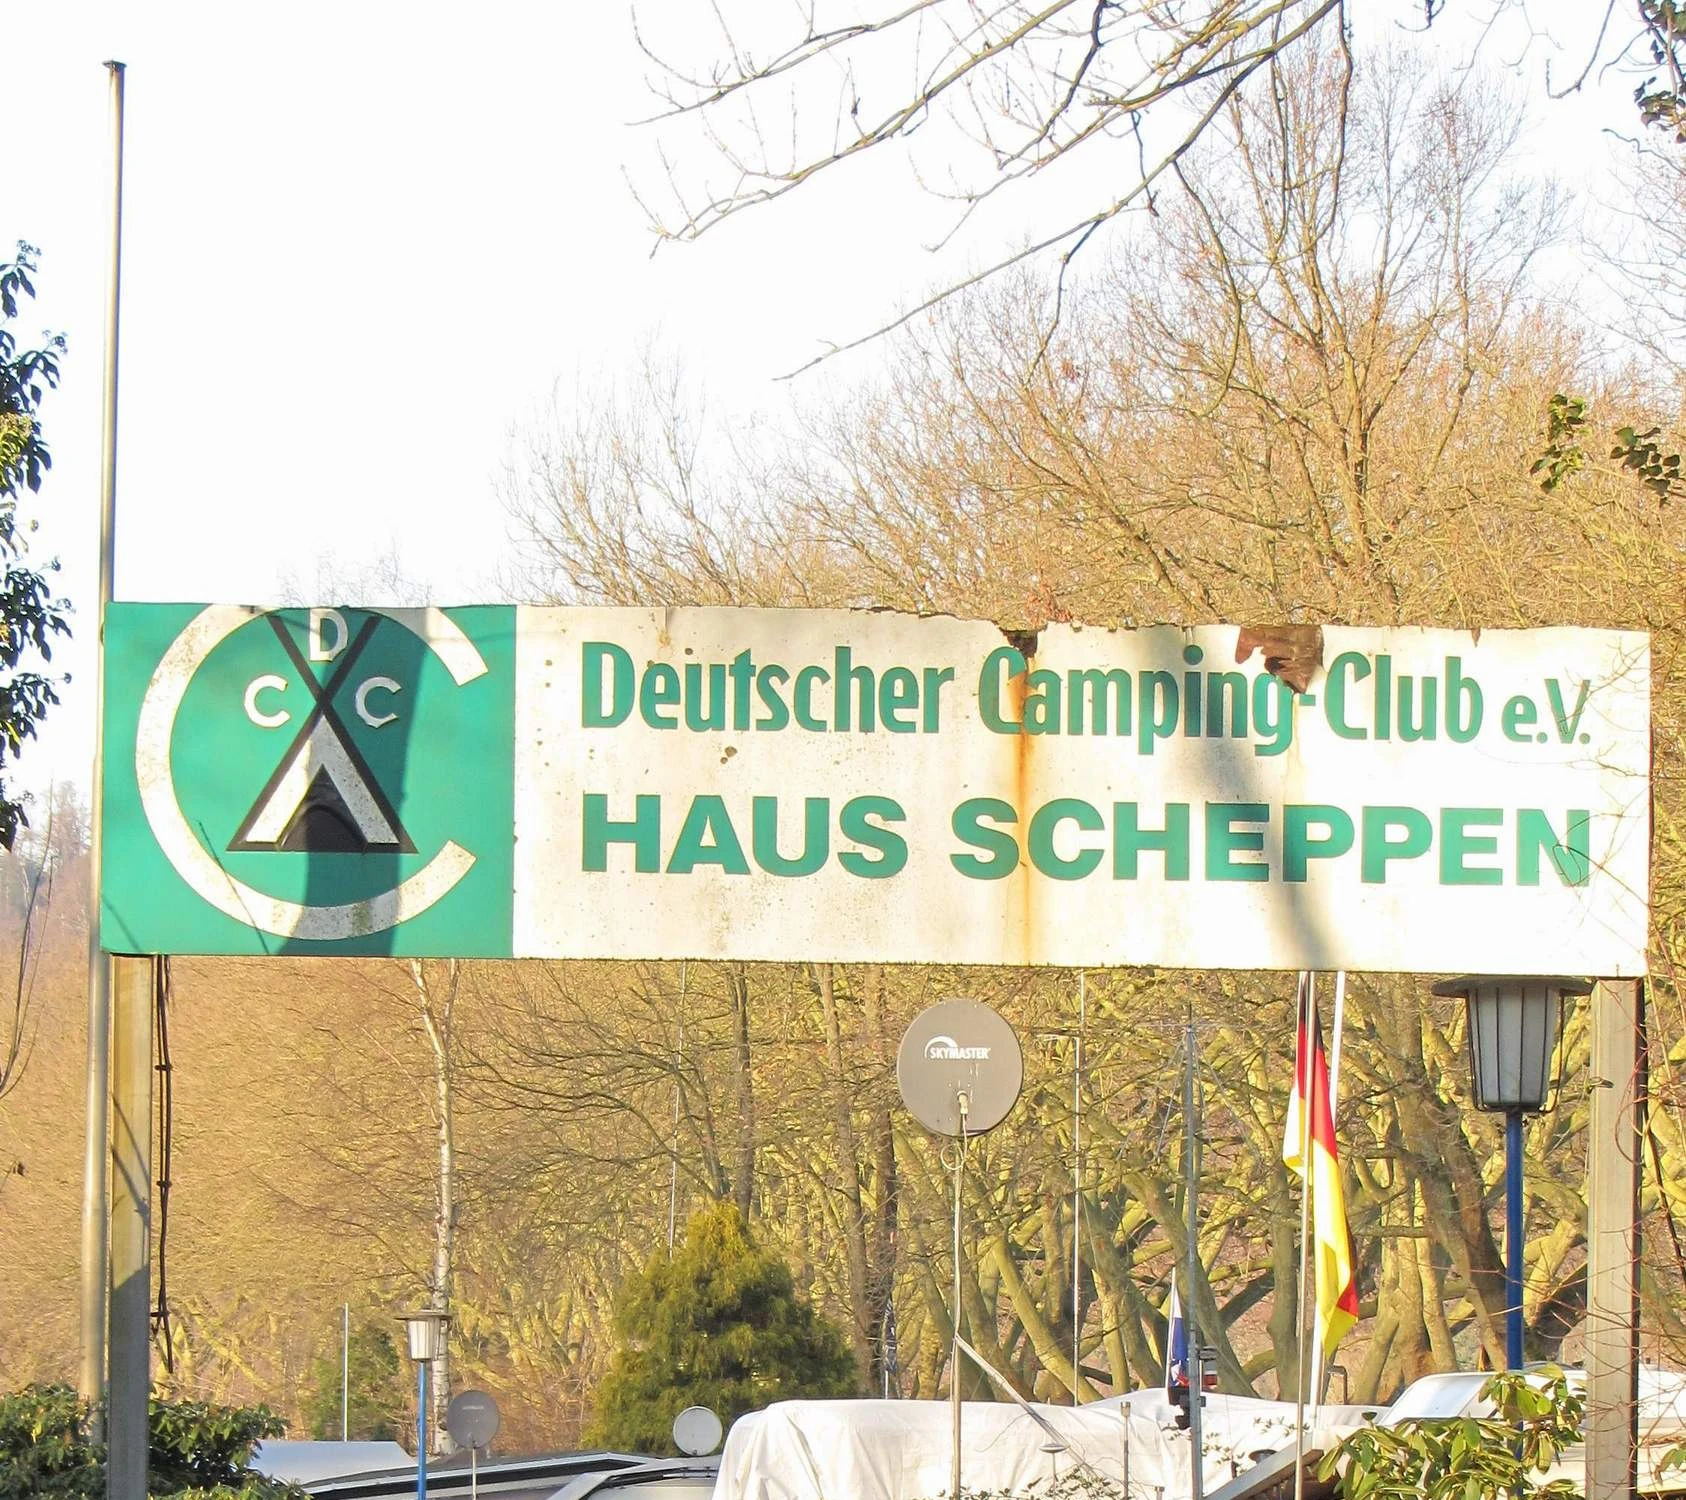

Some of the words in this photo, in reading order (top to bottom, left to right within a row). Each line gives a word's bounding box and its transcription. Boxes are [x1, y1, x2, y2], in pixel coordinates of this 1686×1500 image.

[582, 642, 955, 734] Deutscher
[979, 645, 1484, 756] Camping-Club
[1501, 677, 1592, 745] e.V.
[583, 793, 908, 880] HAUS
[951, 797, 1591, 887] SCHEPPEN
[929, 1047, 990, 1059] SKYMASTER
